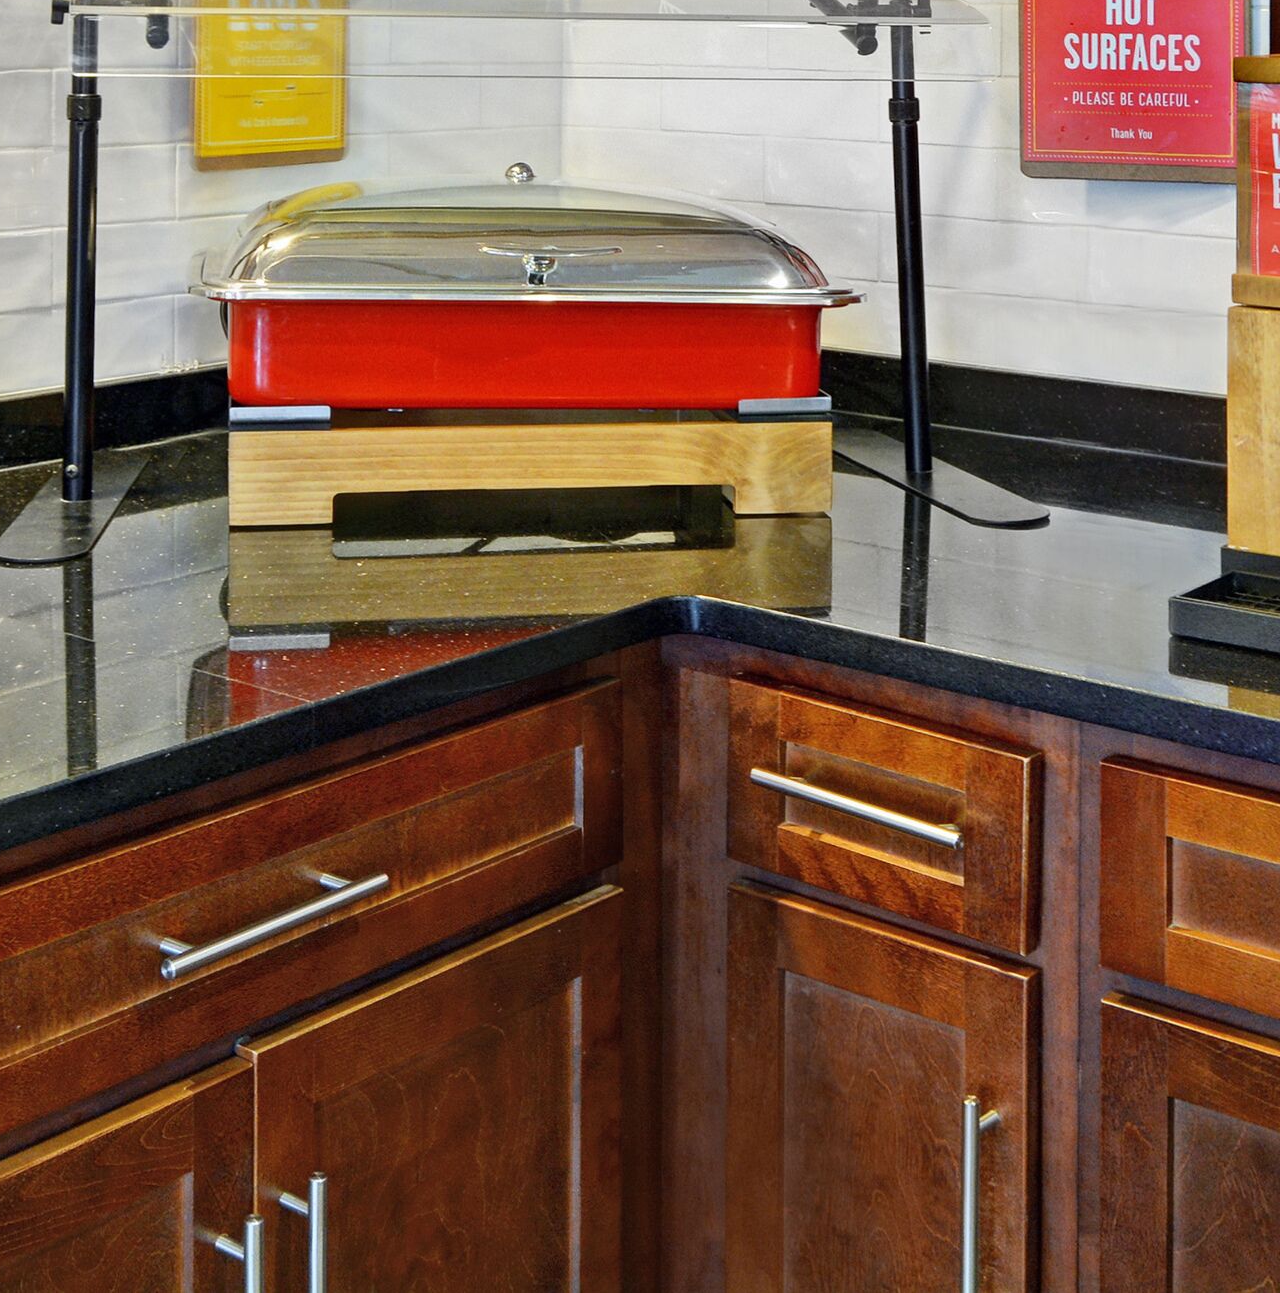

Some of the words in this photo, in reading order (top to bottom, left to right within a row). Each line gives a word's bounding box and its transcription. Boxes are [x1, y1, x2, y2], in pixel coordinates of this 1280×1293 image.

[1063, 32, 1201, 72] SURFACES
[1072, 90, 1115, 106] PLEASE
[1119, 91, 1134, 107] BE
[1138, 92, 1191, 108] CAREFUL
[1110, 127, 1135, 139] Thank
[1137, 128, 1153, 140] You
[1271, 244, 1280, 254] A
